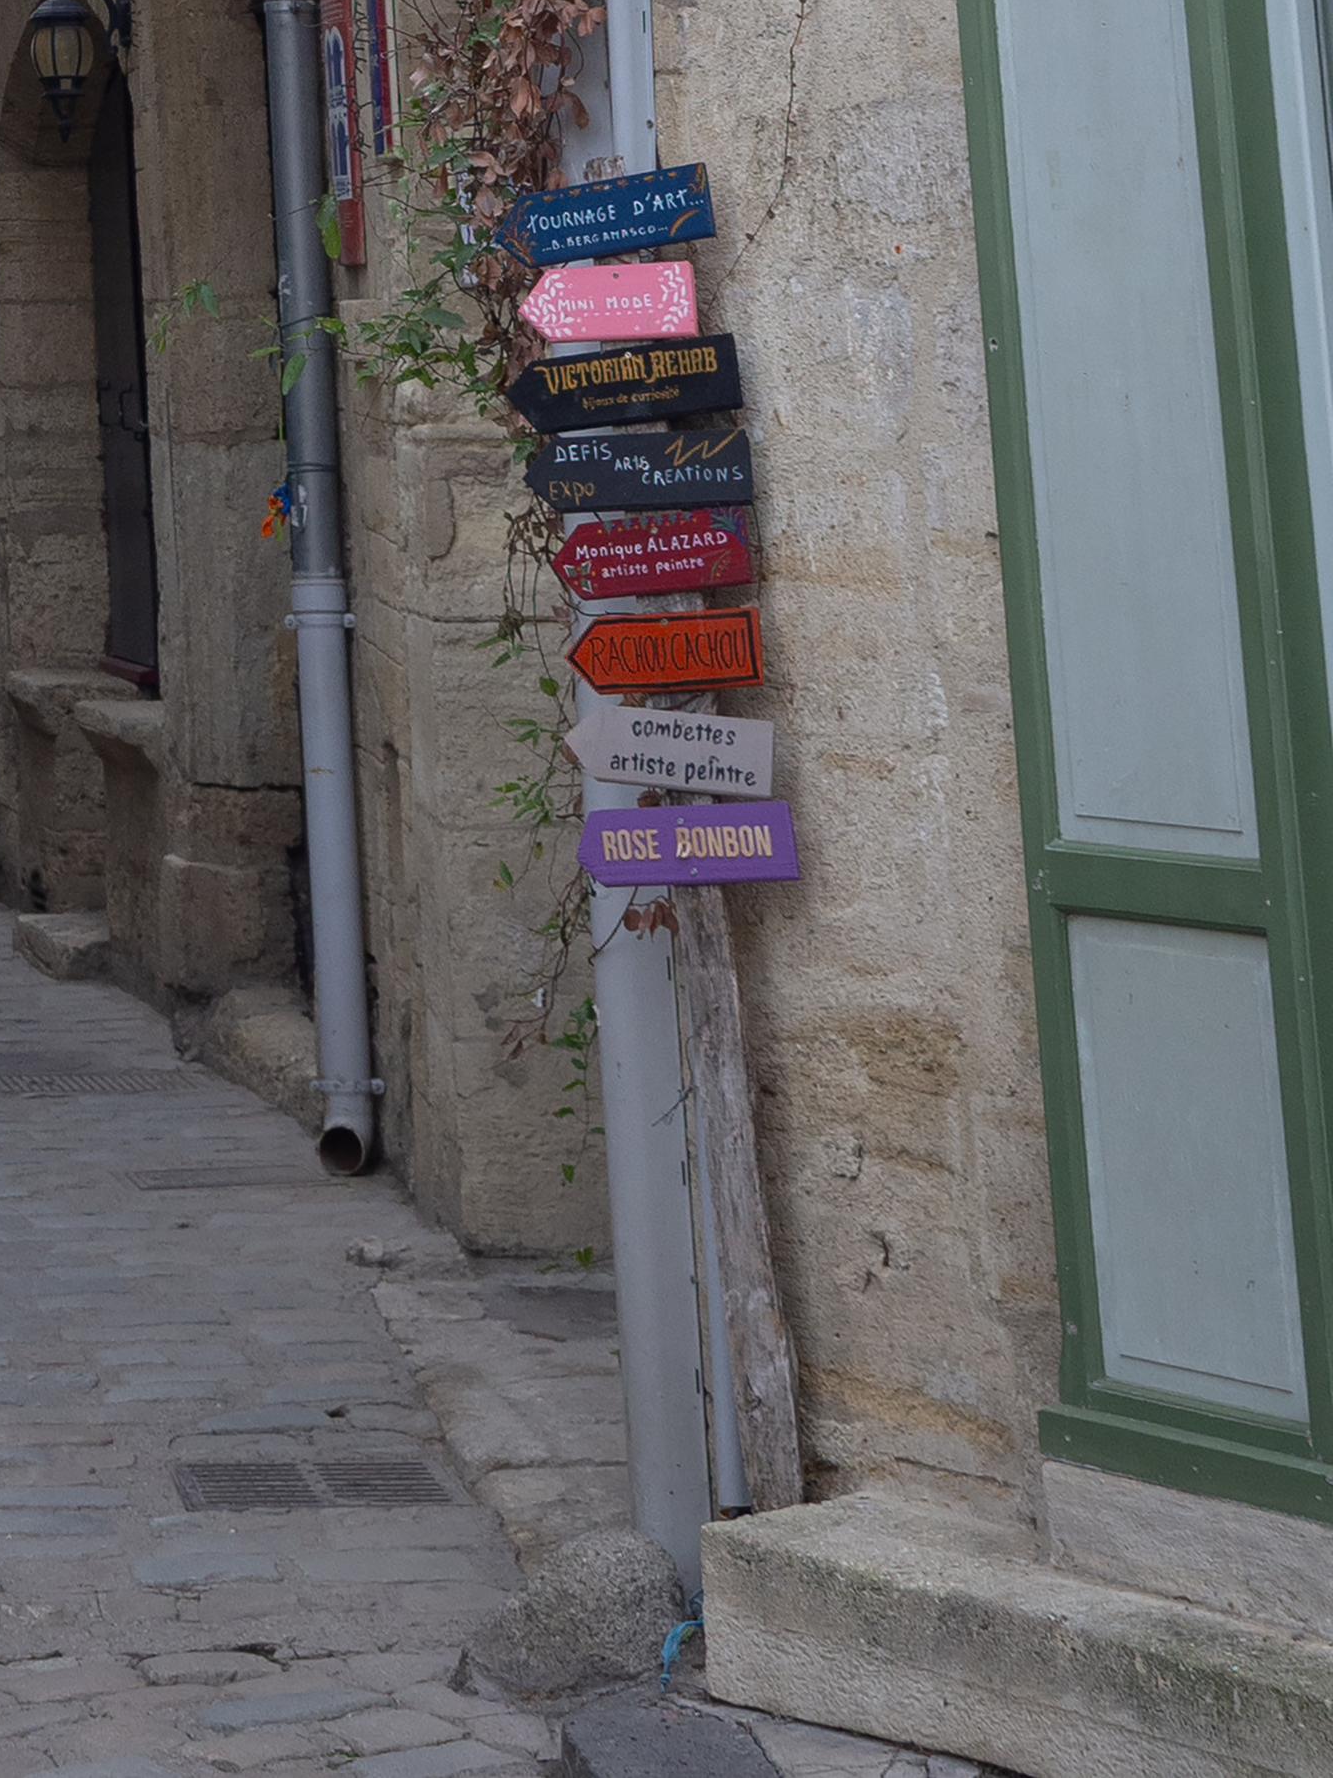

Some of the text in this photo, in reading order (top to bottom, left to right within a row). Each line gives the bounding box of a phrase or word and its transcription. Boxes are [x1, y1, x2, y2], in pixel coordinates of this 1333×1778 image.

[527, 205, 617, 234] TOURNAGE
[606, 293, 653, 308] MODE
[533, 346, 719, 394] VICTORIAN REHAB
[575, 531, 729, 561] Monique ALAZARD
[601, 556, 705, 579] artiste peintre
[588, 628, 747, 676] RACHOU CACHOU
[632, 718, 736, 746] combettes
[610, 752, 676, 777] artiste
[601, 824, 773, 861] ROSE BONBON
